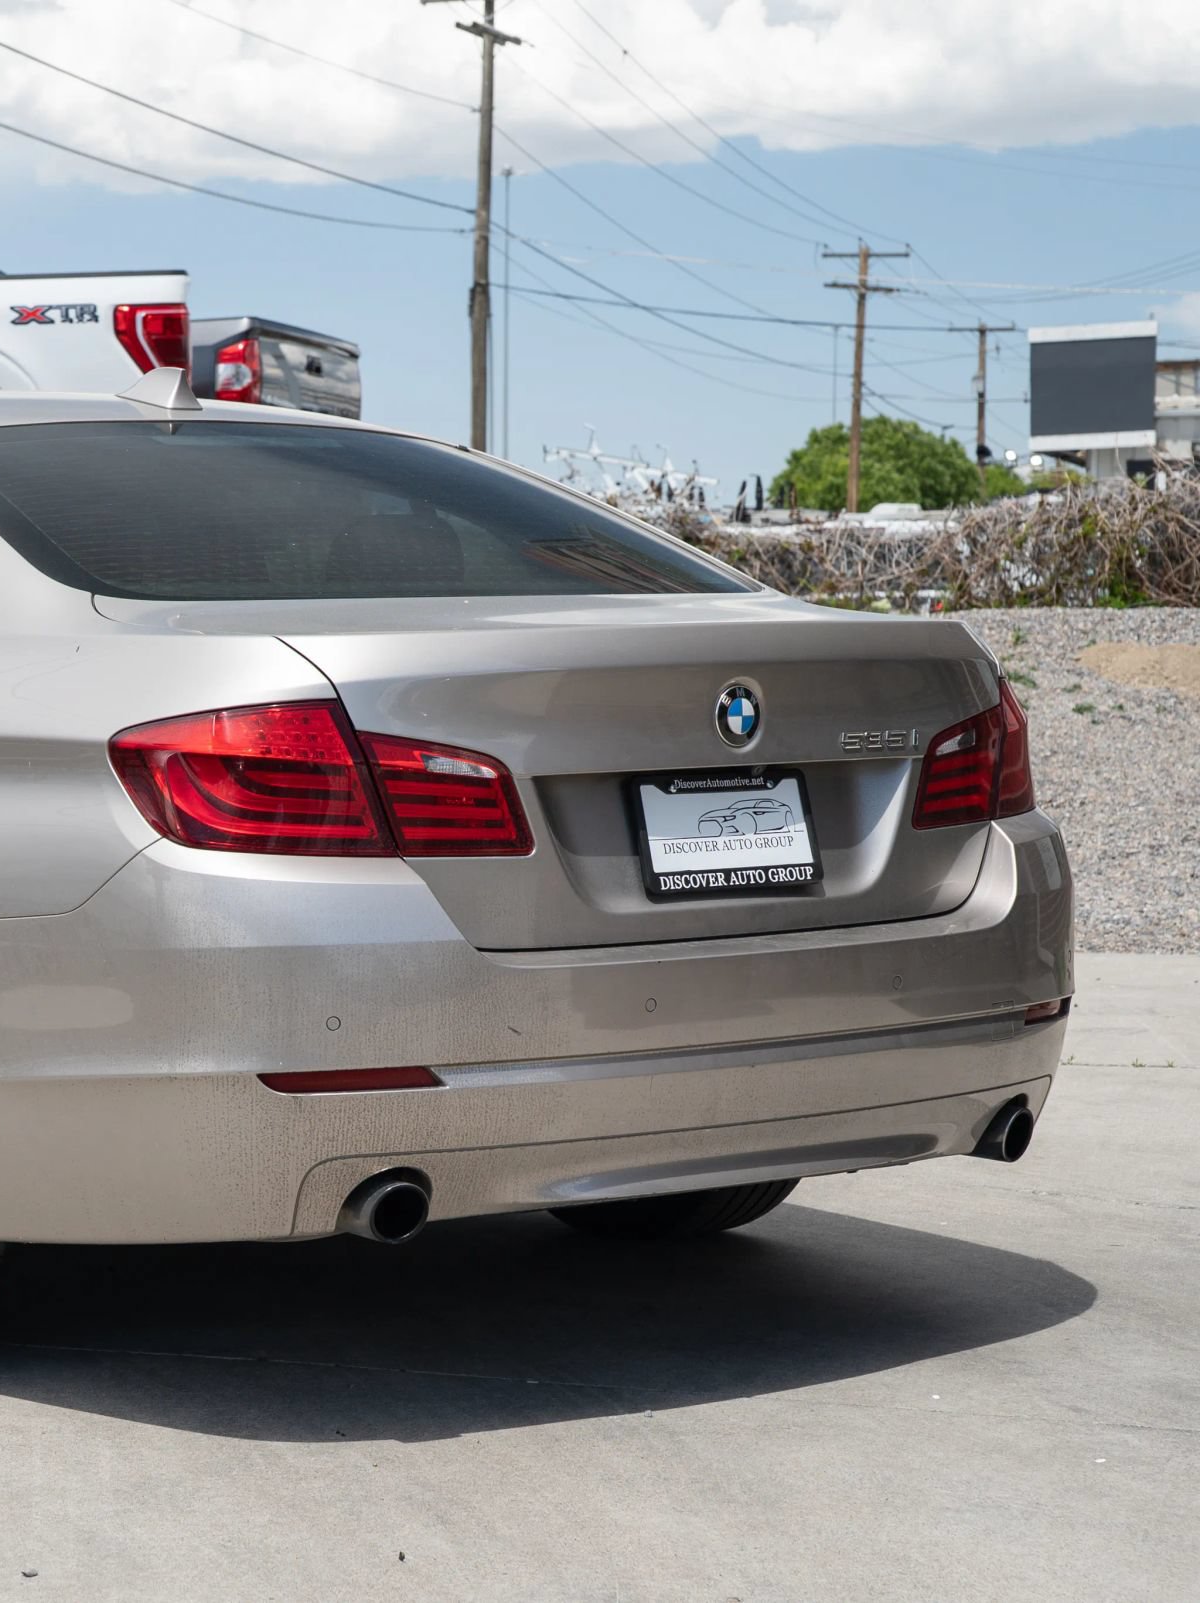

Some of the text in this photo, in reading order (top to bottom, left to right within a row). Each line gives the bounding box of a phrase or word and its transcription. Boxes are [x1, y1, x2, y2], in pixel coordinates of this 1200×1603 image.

[9, 304, 99, 325] XTR
[841, 728, 919, 750] 535i
[674, 776, 765, 790] DiscoverAutomotive.net
[663, 836, 794, 855] DISCOVER AUTO GROUP
[659, 866, 814, 891] DISCOVER AUTO GROUP
